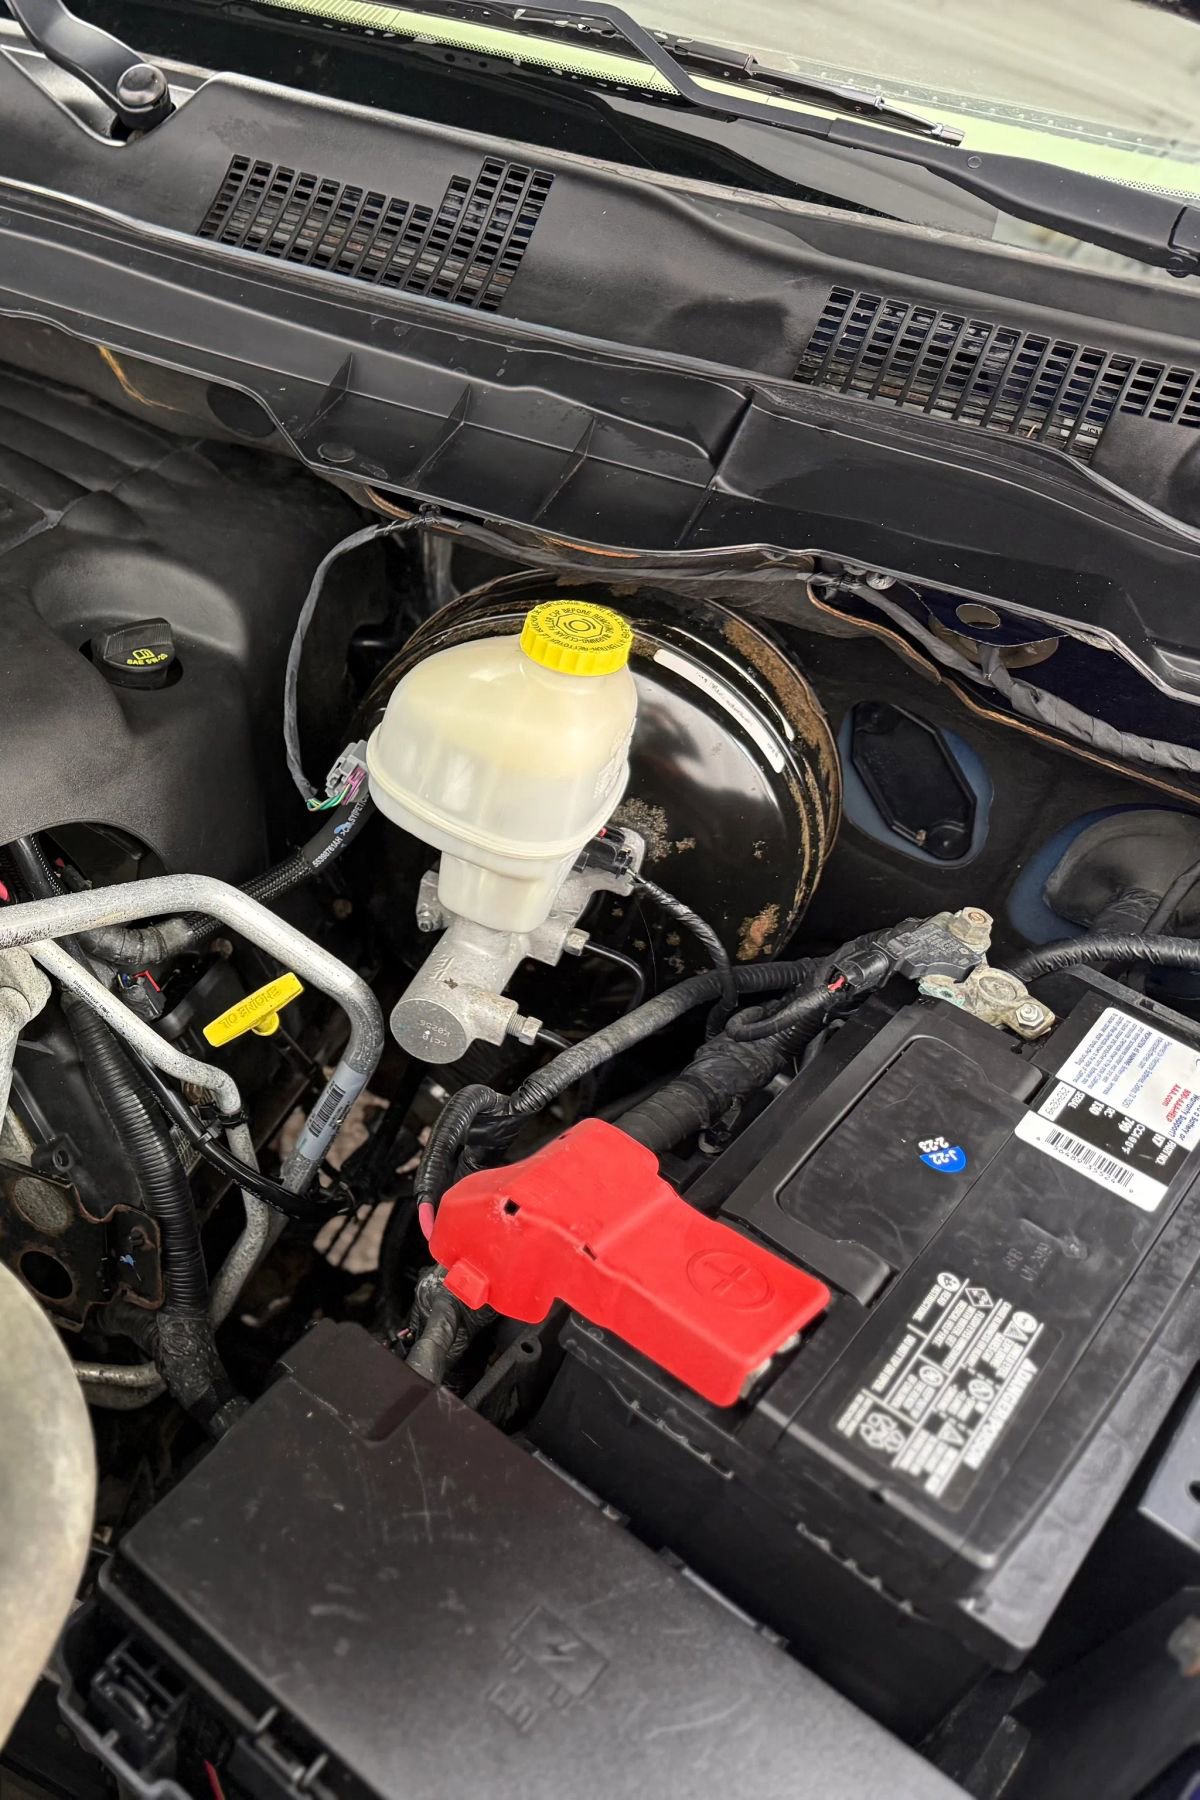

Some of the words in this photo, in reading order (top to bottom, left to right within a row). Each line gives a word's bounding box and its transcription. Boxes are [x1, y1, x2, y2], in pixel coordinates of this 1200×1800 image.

[236, 984, 282, 1019] ENGINE
[218, 1012, 239, 1029] OIL
[1161, 1083, 1182, 1108] AAA.com
[1087, 1099, 1105, 1117] 130
[1129, 1122, 1146, 1139] CCA
[917, 1135, 950, 1153] 2-23
[1149, 1131, 1166, 1148] H7
[1160, 1139, 1177, 1156] PART
[927, 1149, 959, 1166] J-22
